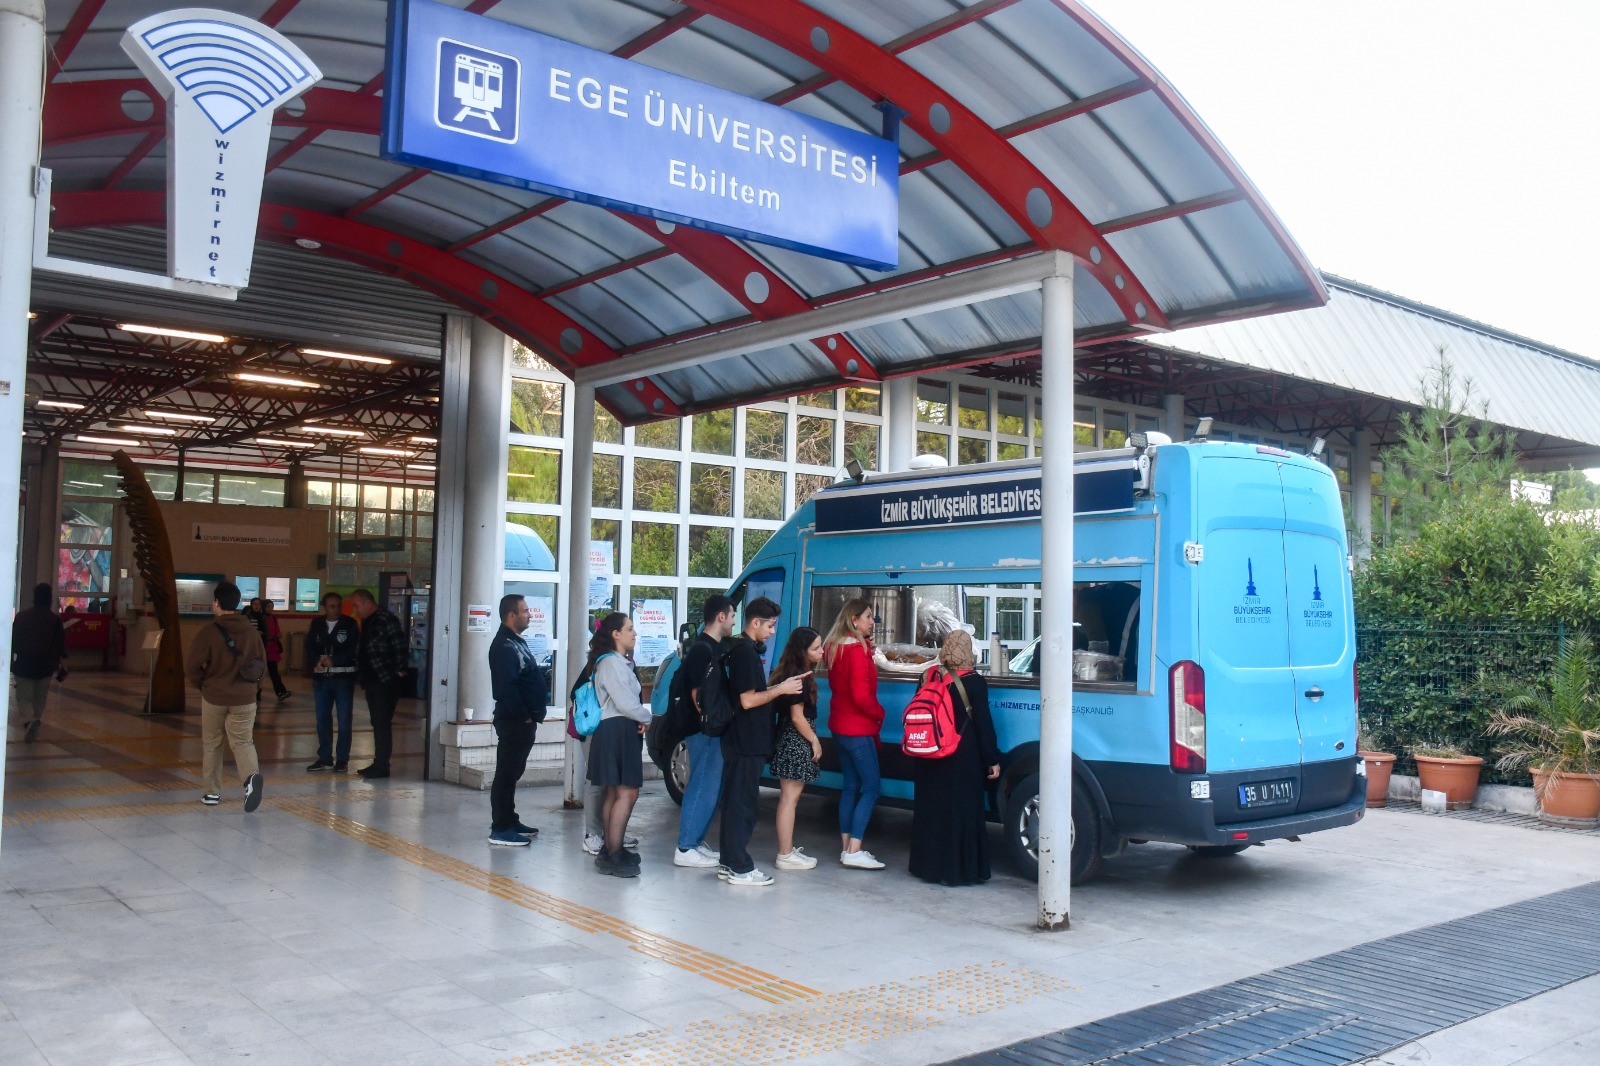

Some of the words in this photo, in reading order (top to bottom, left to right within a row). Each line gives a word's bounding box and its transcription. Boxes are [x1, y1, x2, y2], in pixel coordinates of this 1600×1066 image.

[548, 67, 630, 119] EGE
[644, 89, 879, 188] ÜNİVERSİTESİ
[208, 138, 230, 278] wizmirnet
[669, 159, 781, 212] Ebiltem
[881, 497, 909, 523] İZMİR
[911, 490, 978, 523] BÜYÜKŞEHİR
[980, 485, 1041, 515] BELEDİYES
[908, 732, 926, 740] AFAD
[1245, 786, 1257, 802] 35
[1261, 784, 1268, 800] U
